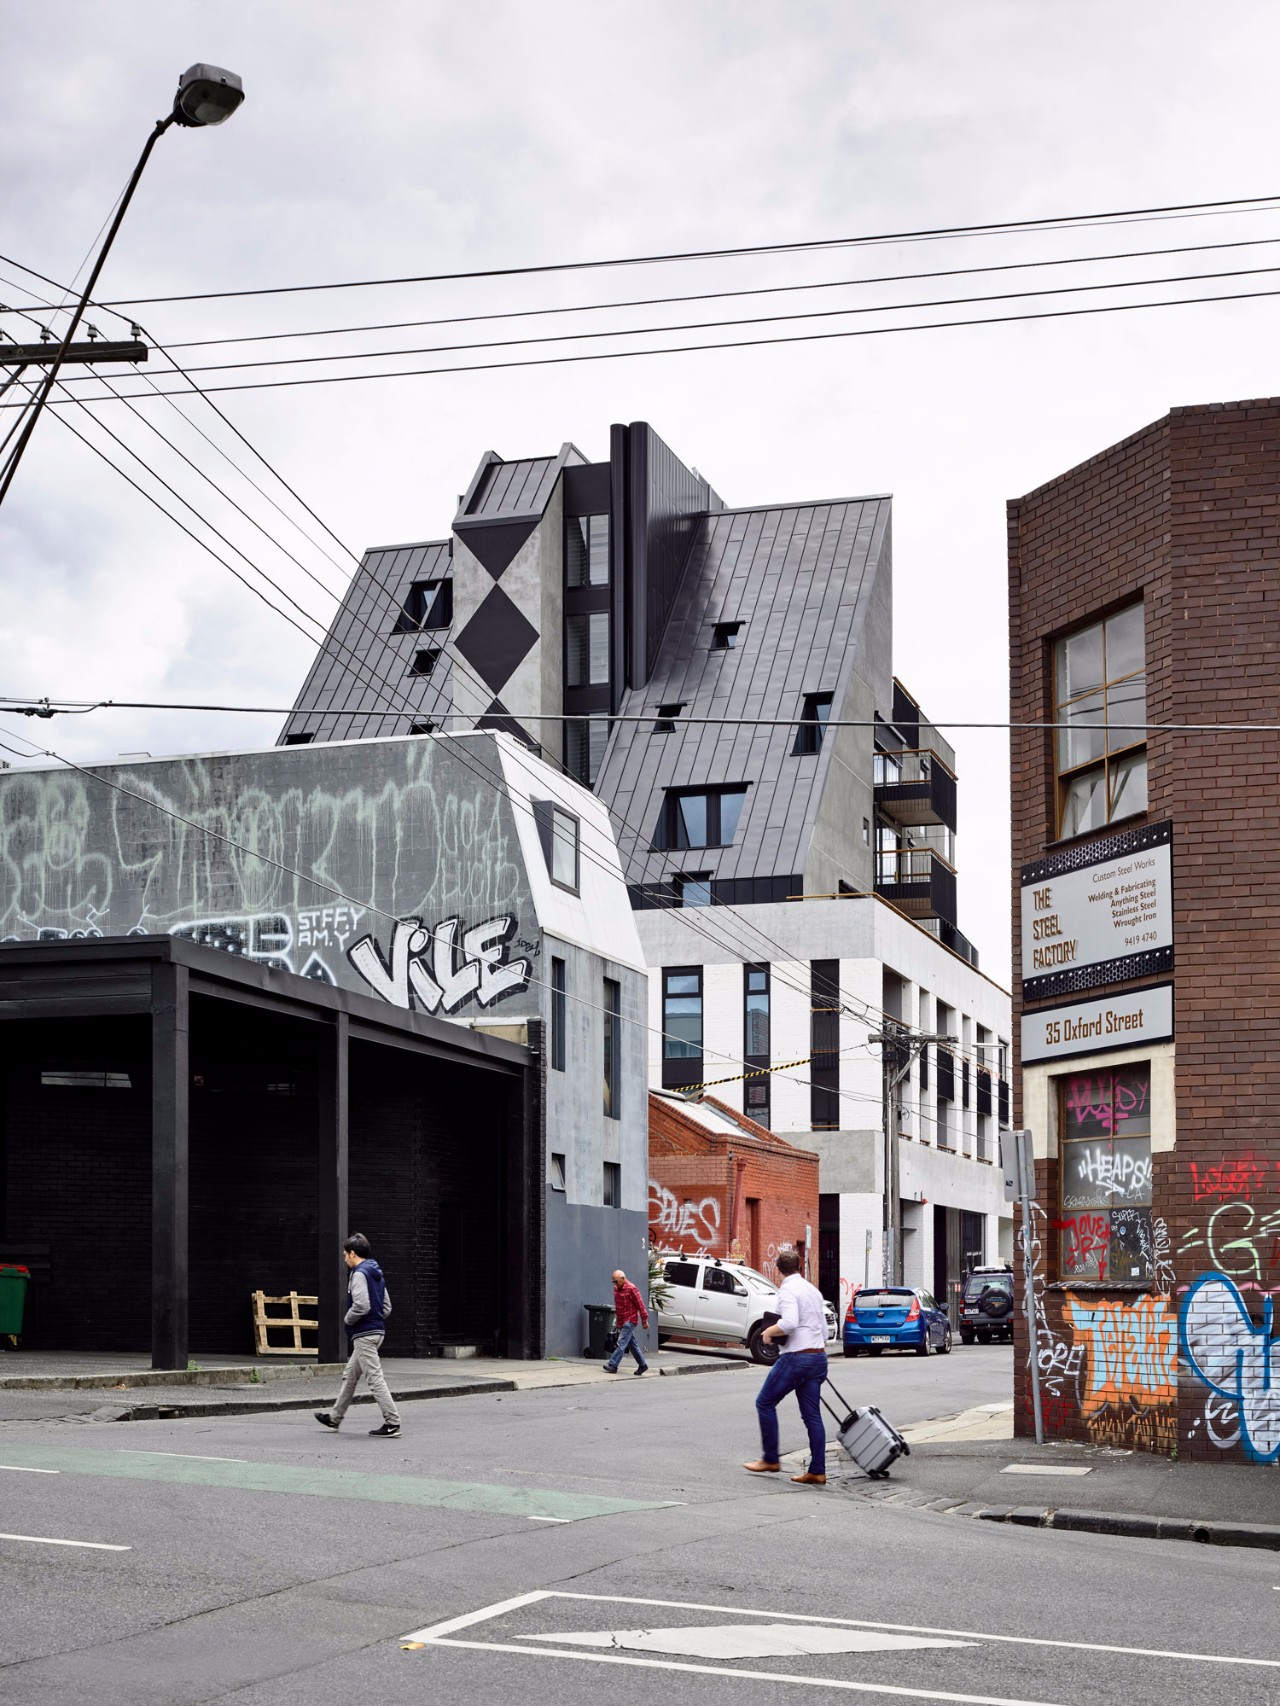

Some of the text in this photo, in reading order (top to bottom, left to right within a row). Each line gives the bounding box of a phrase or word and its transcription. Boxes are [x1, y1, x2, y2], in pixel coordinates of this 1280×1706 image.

[1092, 858, 1156, 883] Custom Steel Works
[1033, 887, 1052, 911] THE
[1088, 879, 1156, 903] Welding & Fabricating
[1110, 888, 1157, 908] Anything Steel
[1112, 899, 1157, 918] Stainless Steel
[1113, 912, 1157, 928] Wrought Iron
[1033, 914, 1063, 940] STEEL
[1124, 931, 1158, 947] 9419 4740
[1033, 939, 1077, 969] FACTORY
[1046, 1008, 1143, 1045] 35 Oxford Street
